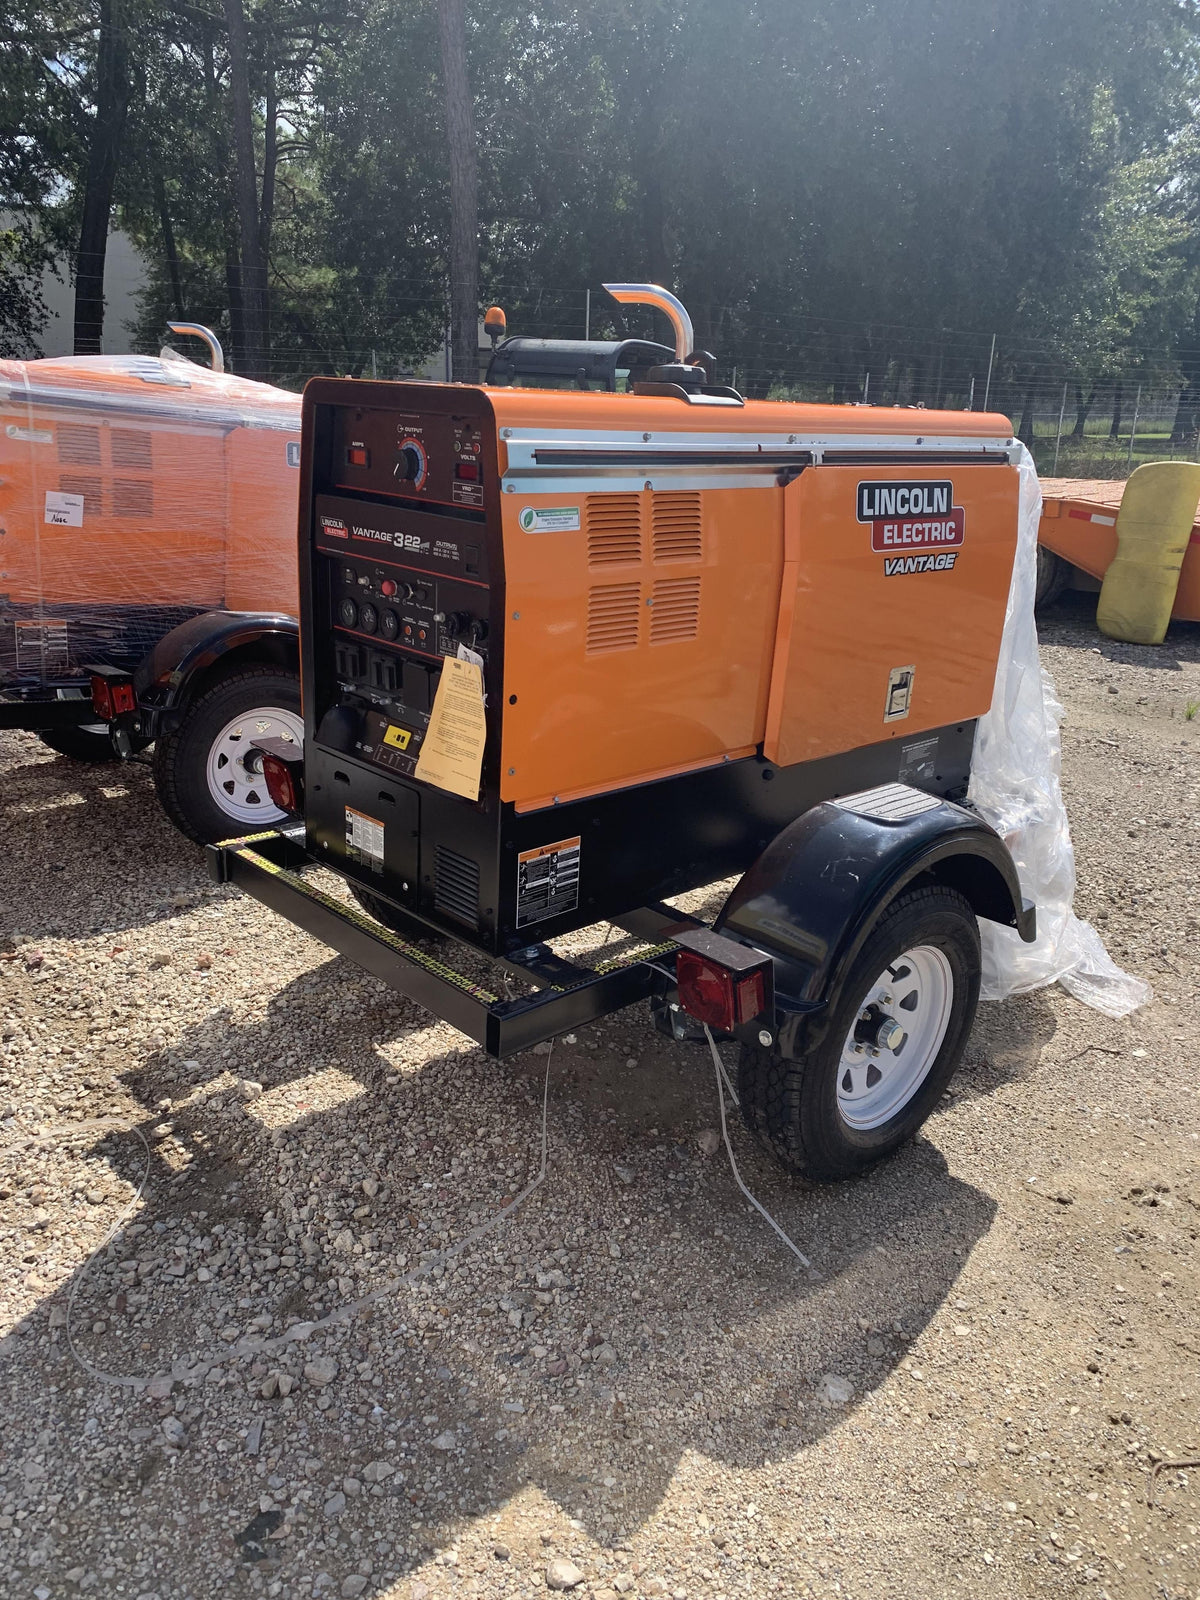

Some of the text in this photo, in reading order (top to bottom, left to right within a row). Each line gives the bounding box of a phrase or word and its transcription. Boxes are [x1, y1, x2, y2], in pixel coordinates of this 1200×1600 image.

[862, 487, 948, 516] LINCOLN
[321, 518, 343, 529] LINCOLN
[883, 521, 956, 545] ELECTRIC
[352, 526, 393, 542] VANTAGE
[393, 532, 421, 547] 322
[884, 552, 958, 576] VANTAGE
